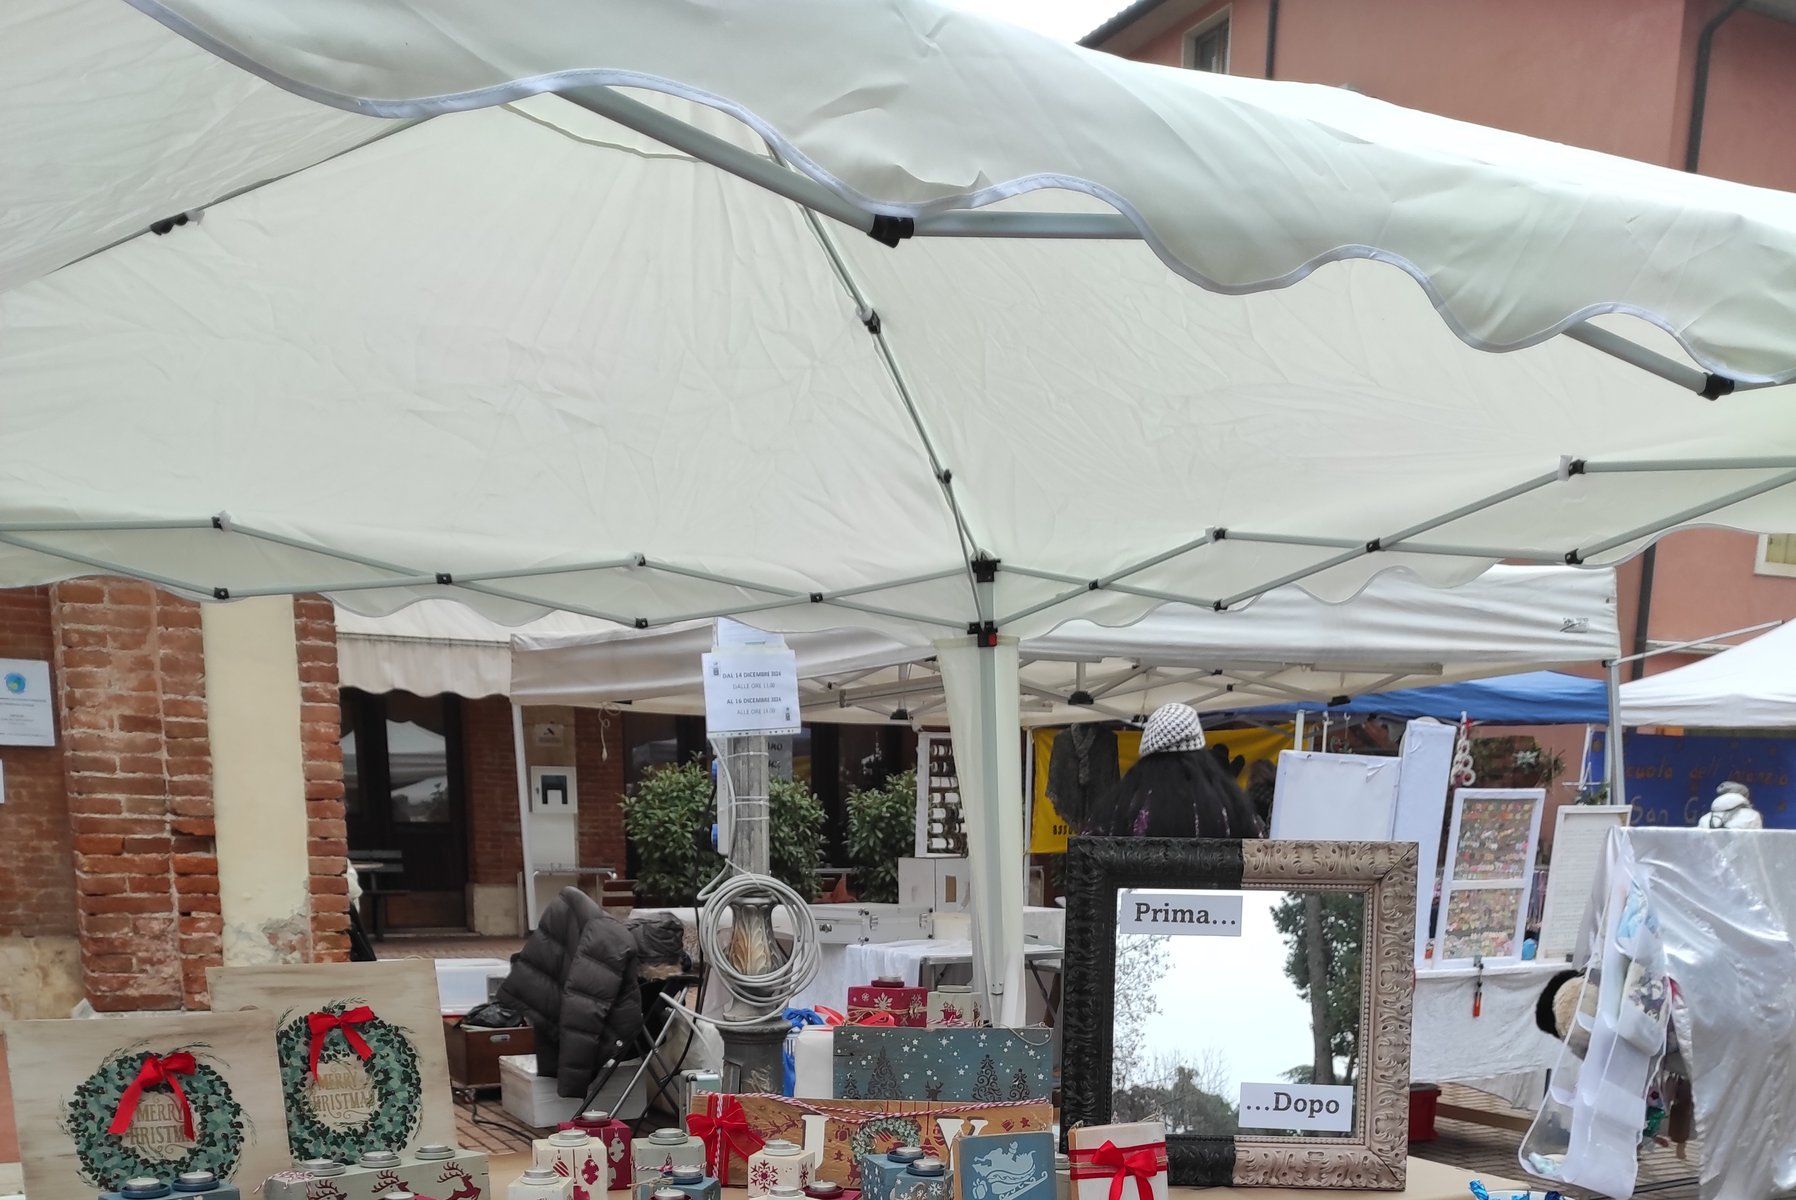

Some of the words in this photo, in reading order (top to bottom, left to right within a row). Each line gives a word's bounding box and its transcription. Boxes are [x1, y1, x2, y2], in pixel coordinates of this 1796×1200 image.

[1624, 757, 1674, 779] cuola
[1631, 795, 1669, 825] San
[1134, 902, 1237, 926] Prima...
[1246, 1091, 1341, 1119] ...Dopo
